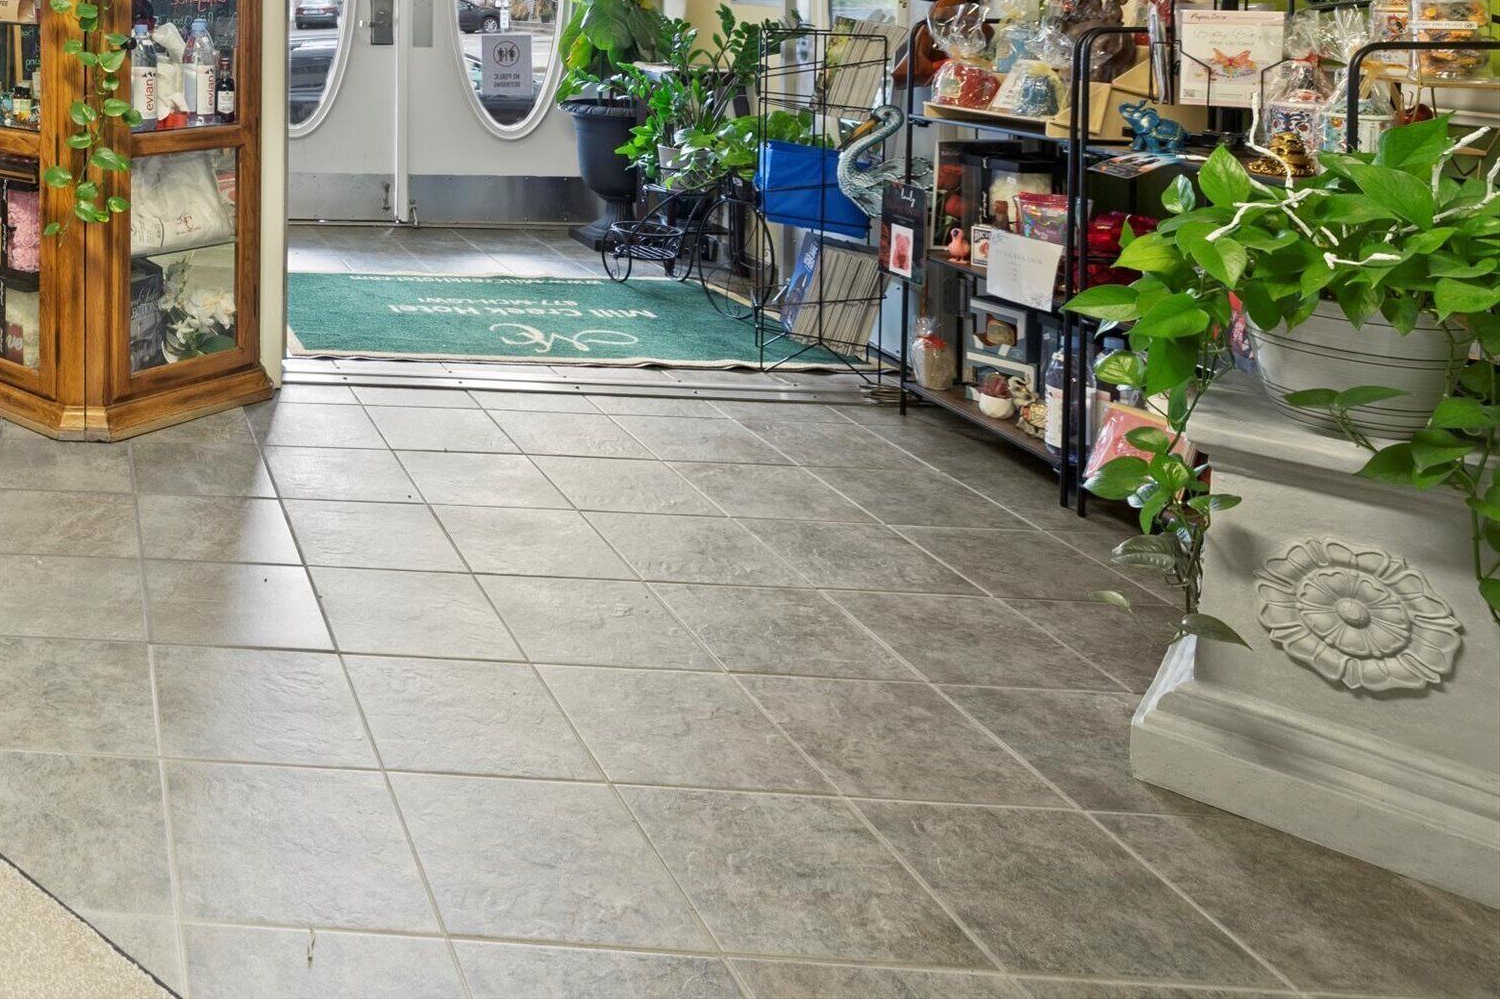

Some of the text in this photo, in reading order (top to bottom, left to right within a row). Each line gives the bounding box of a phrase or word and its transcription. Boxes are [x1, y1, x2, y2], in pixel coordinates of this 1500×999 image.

[146, 78, 154, 111] evian
[389, 304, 658, 318] Mill Creek Hotel
